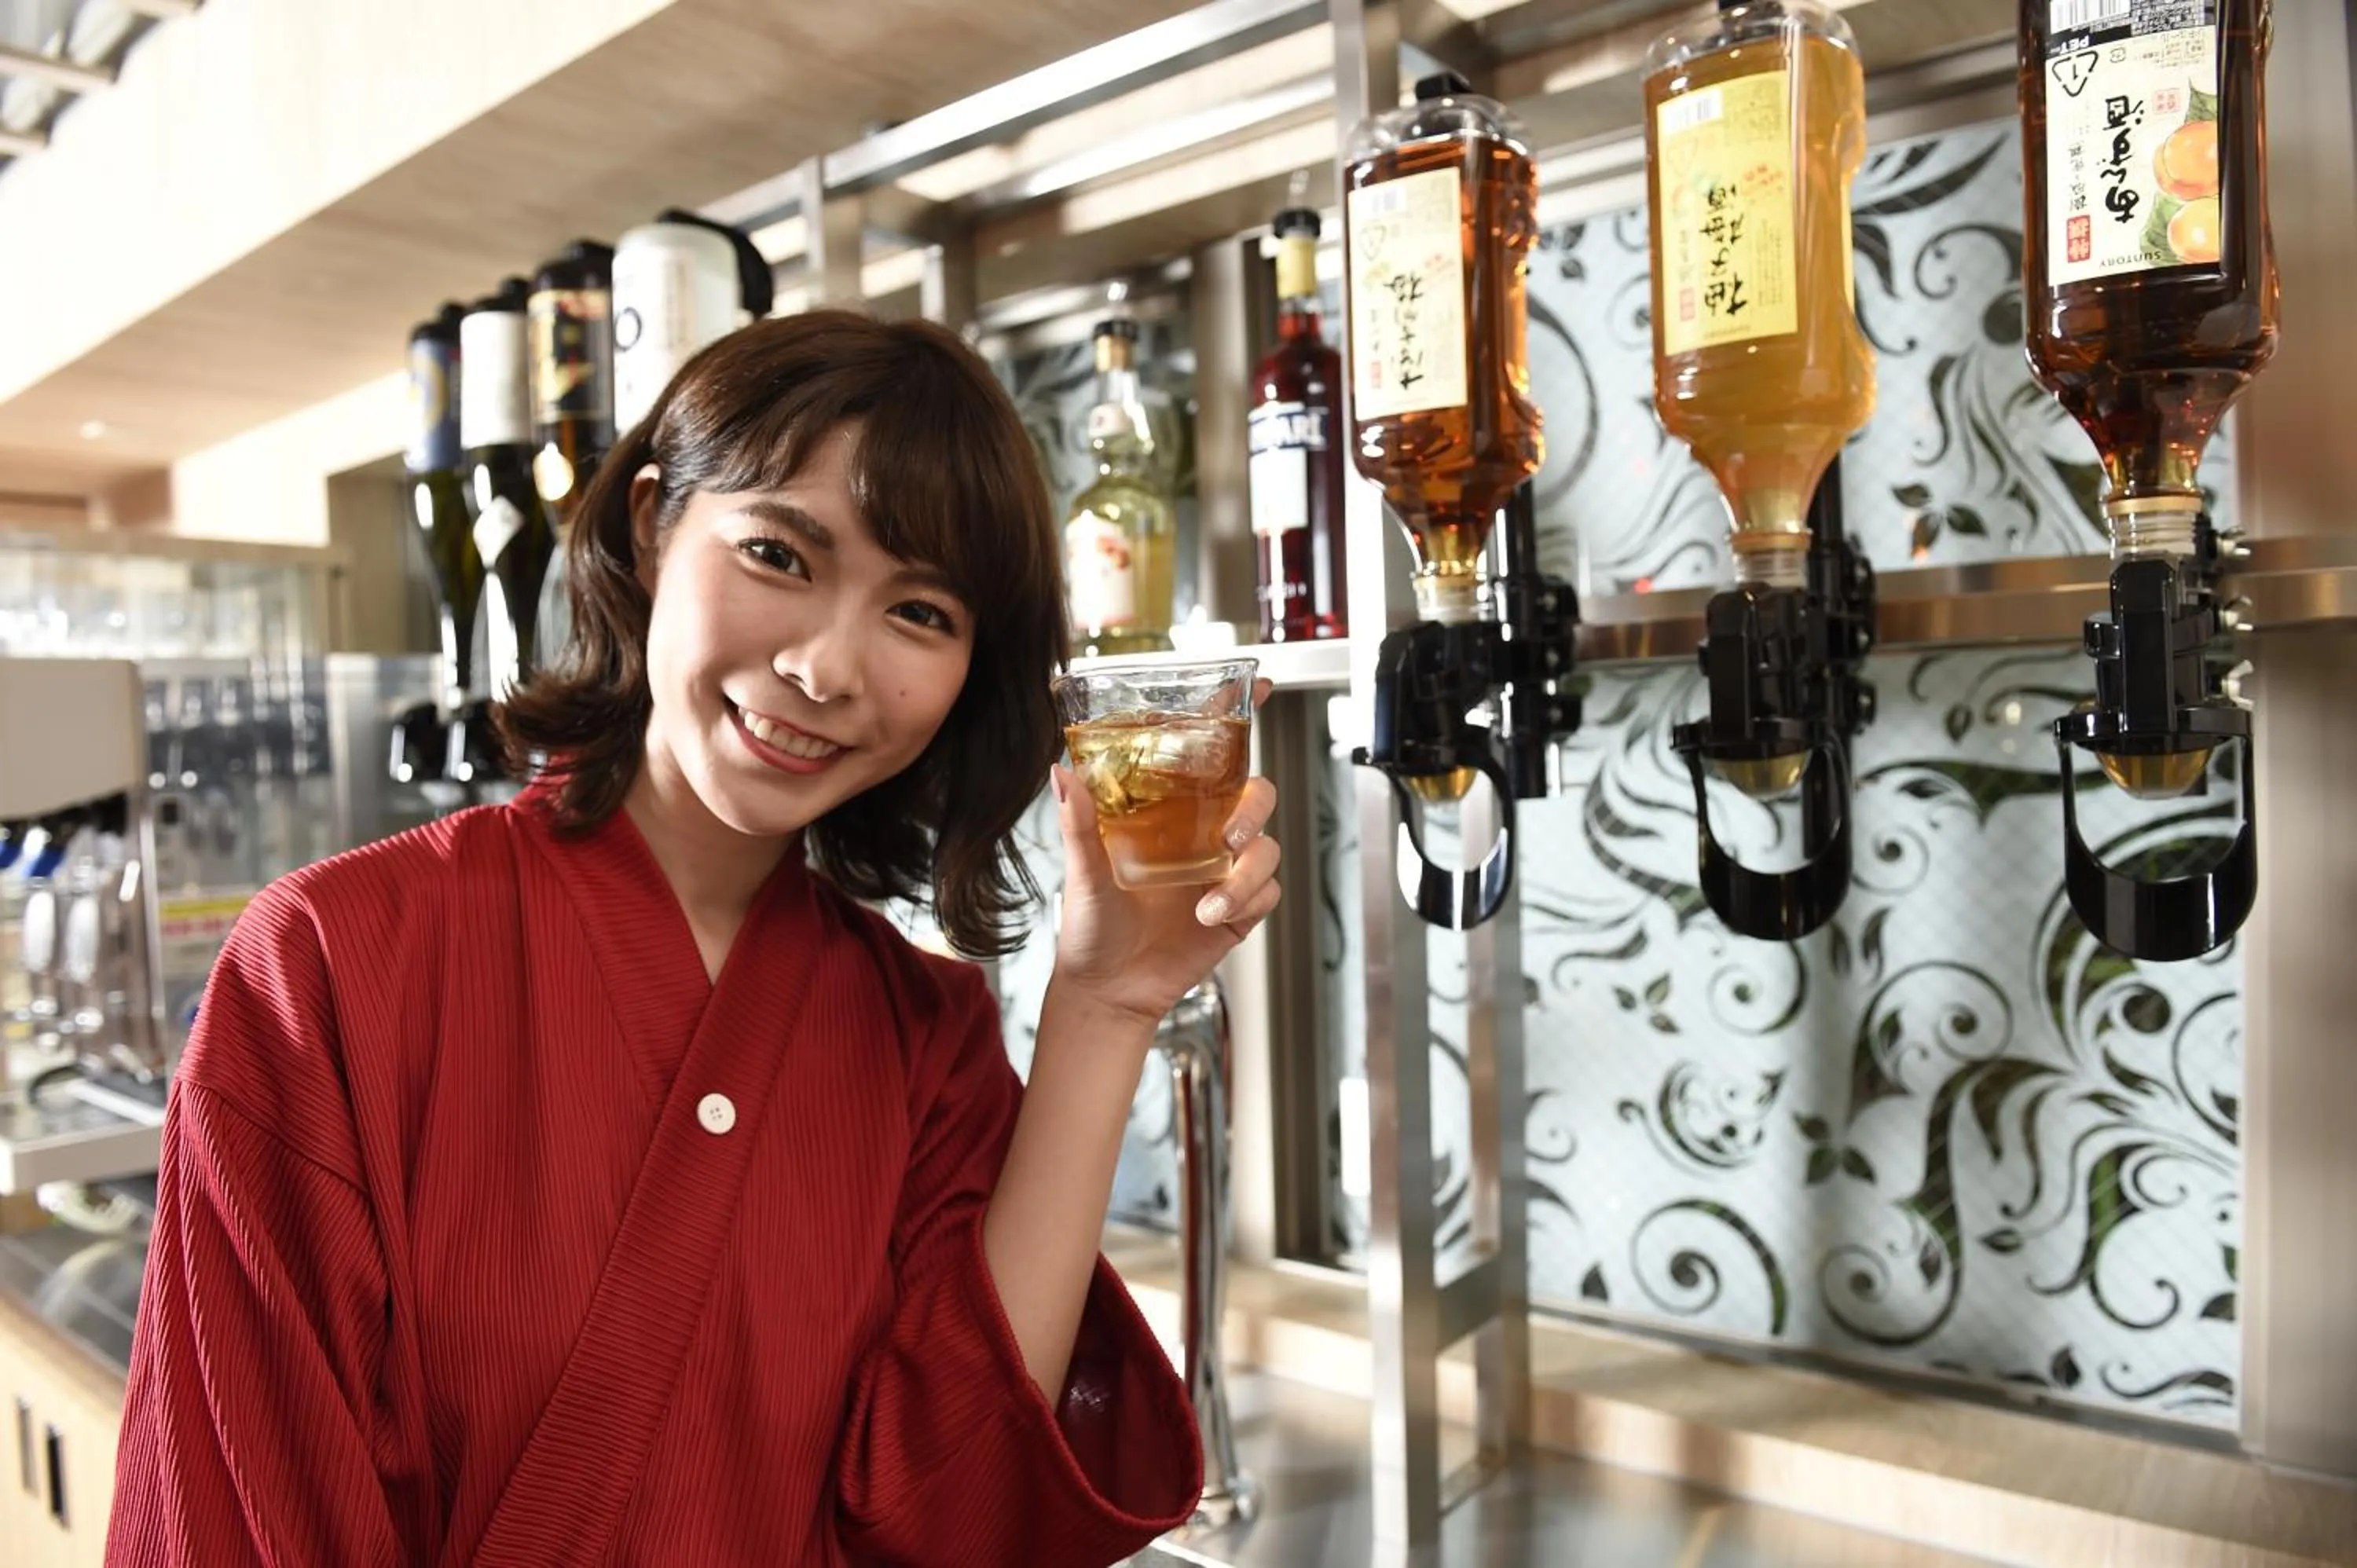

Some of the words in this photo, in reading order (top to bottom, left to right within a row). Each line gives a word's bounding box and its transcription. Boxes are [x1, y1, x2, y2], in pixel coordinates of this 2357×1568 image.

[2060, 36, 2090, 54] PET
[2072, 64, 2080, 80] 1
[2097, 94, 2144, 224] あんず酒
[1699, 183, 1748, 317] 柚子梅酒
[2099, 250, 2161, 269] SUNTORY
